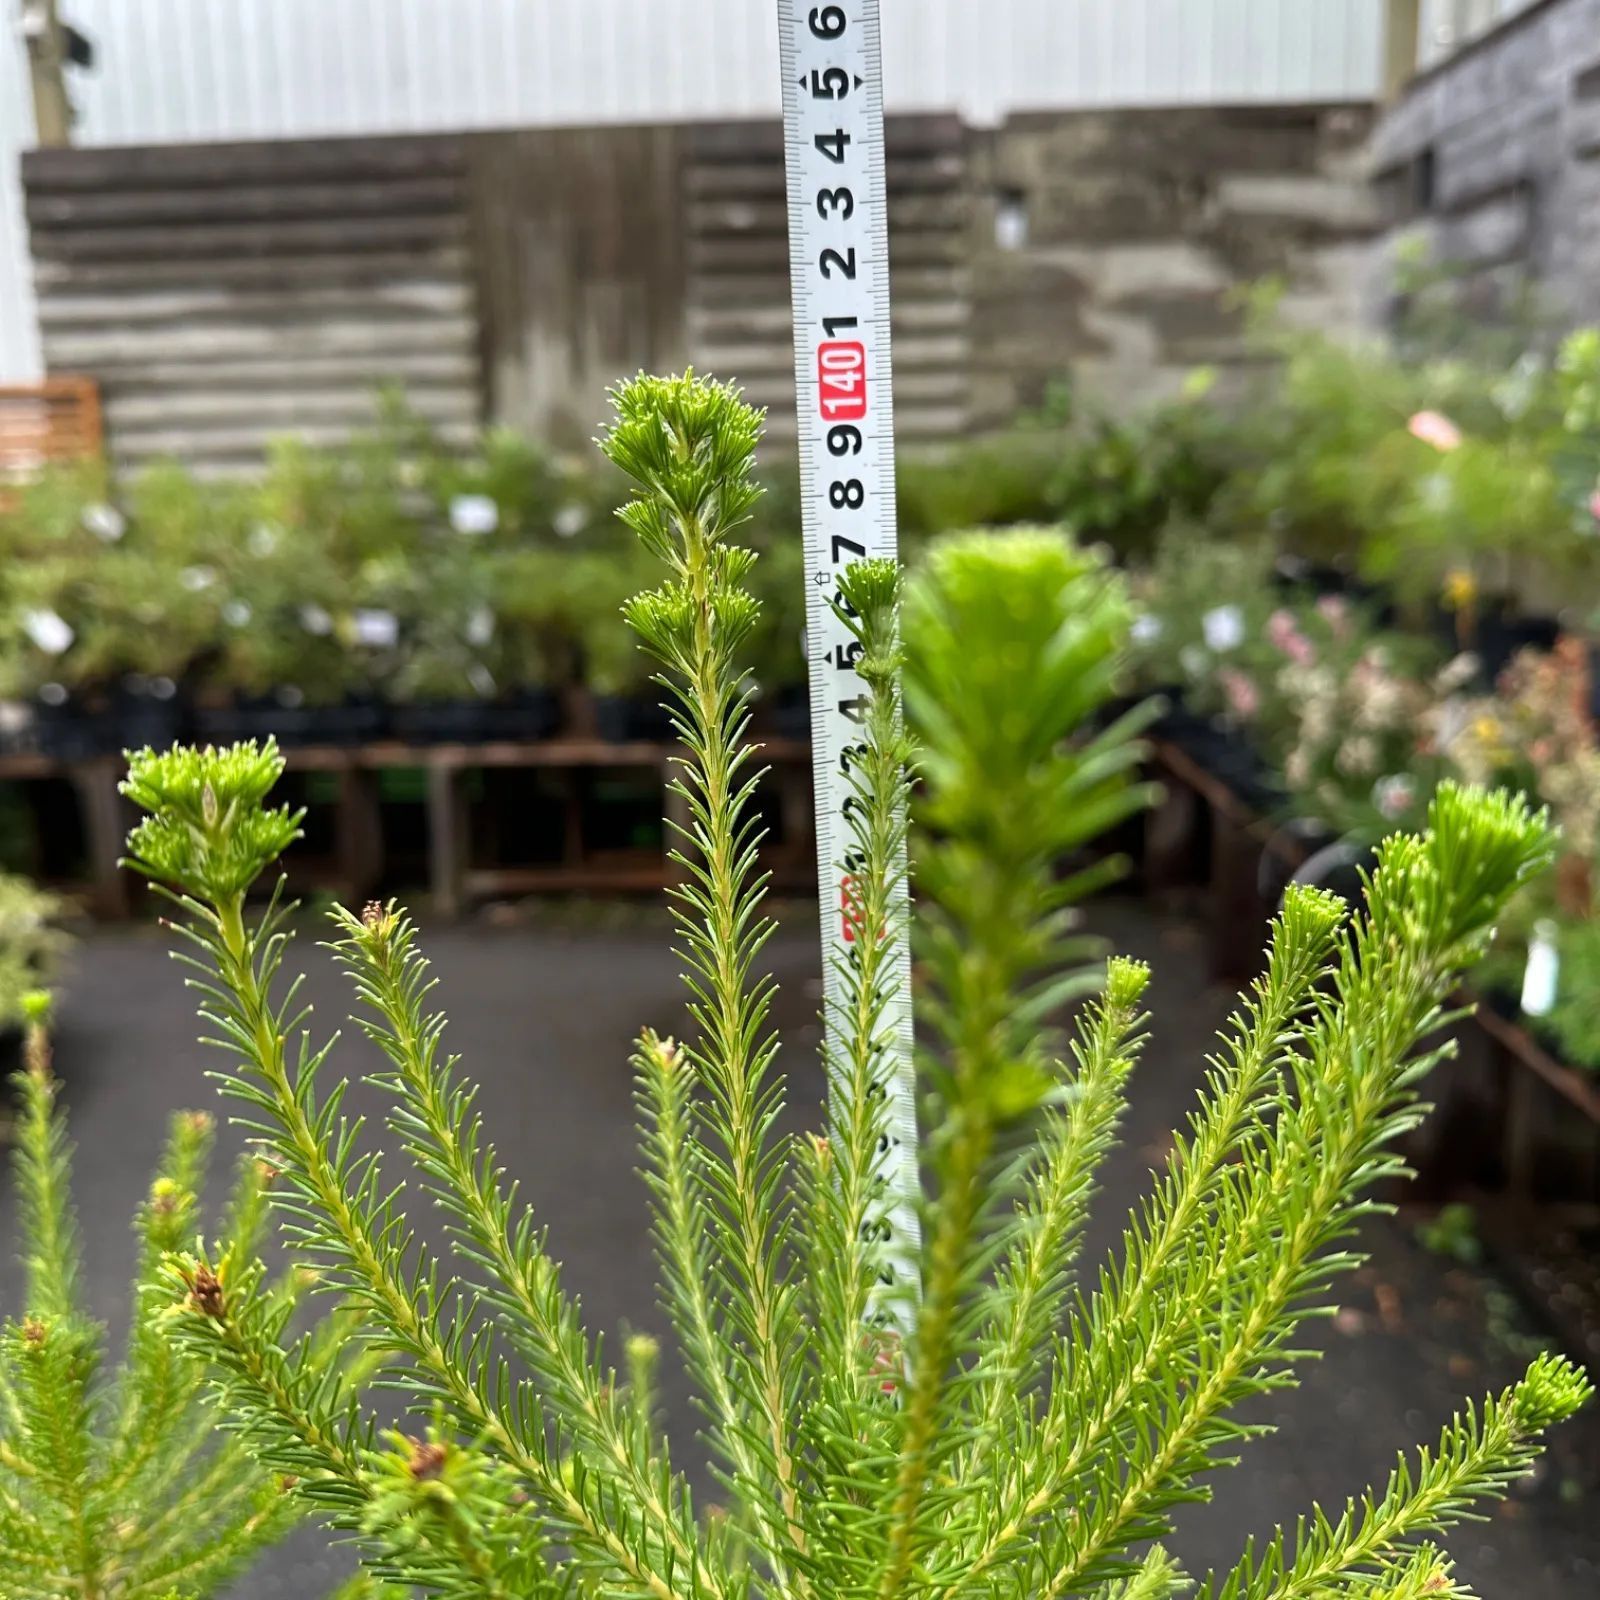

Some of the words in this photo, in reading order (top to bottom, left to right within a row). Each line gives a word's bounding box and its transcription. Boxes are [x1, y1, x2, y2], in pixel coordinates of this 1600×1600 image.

[808, 5, 847, 41] 6
[811, 67, 849, 101] 5
[814, 128, 851, 164] 4
[816, 187, 854, 221] 3
[819, 247, 856, 280] 2
[822, 316, 858, 338] 1
[820, 347, 863, 414] 140
[827, 424, 862, 457] 9
[829, 478, 864, 510] 8
[831, 535, 866, 564] 7
